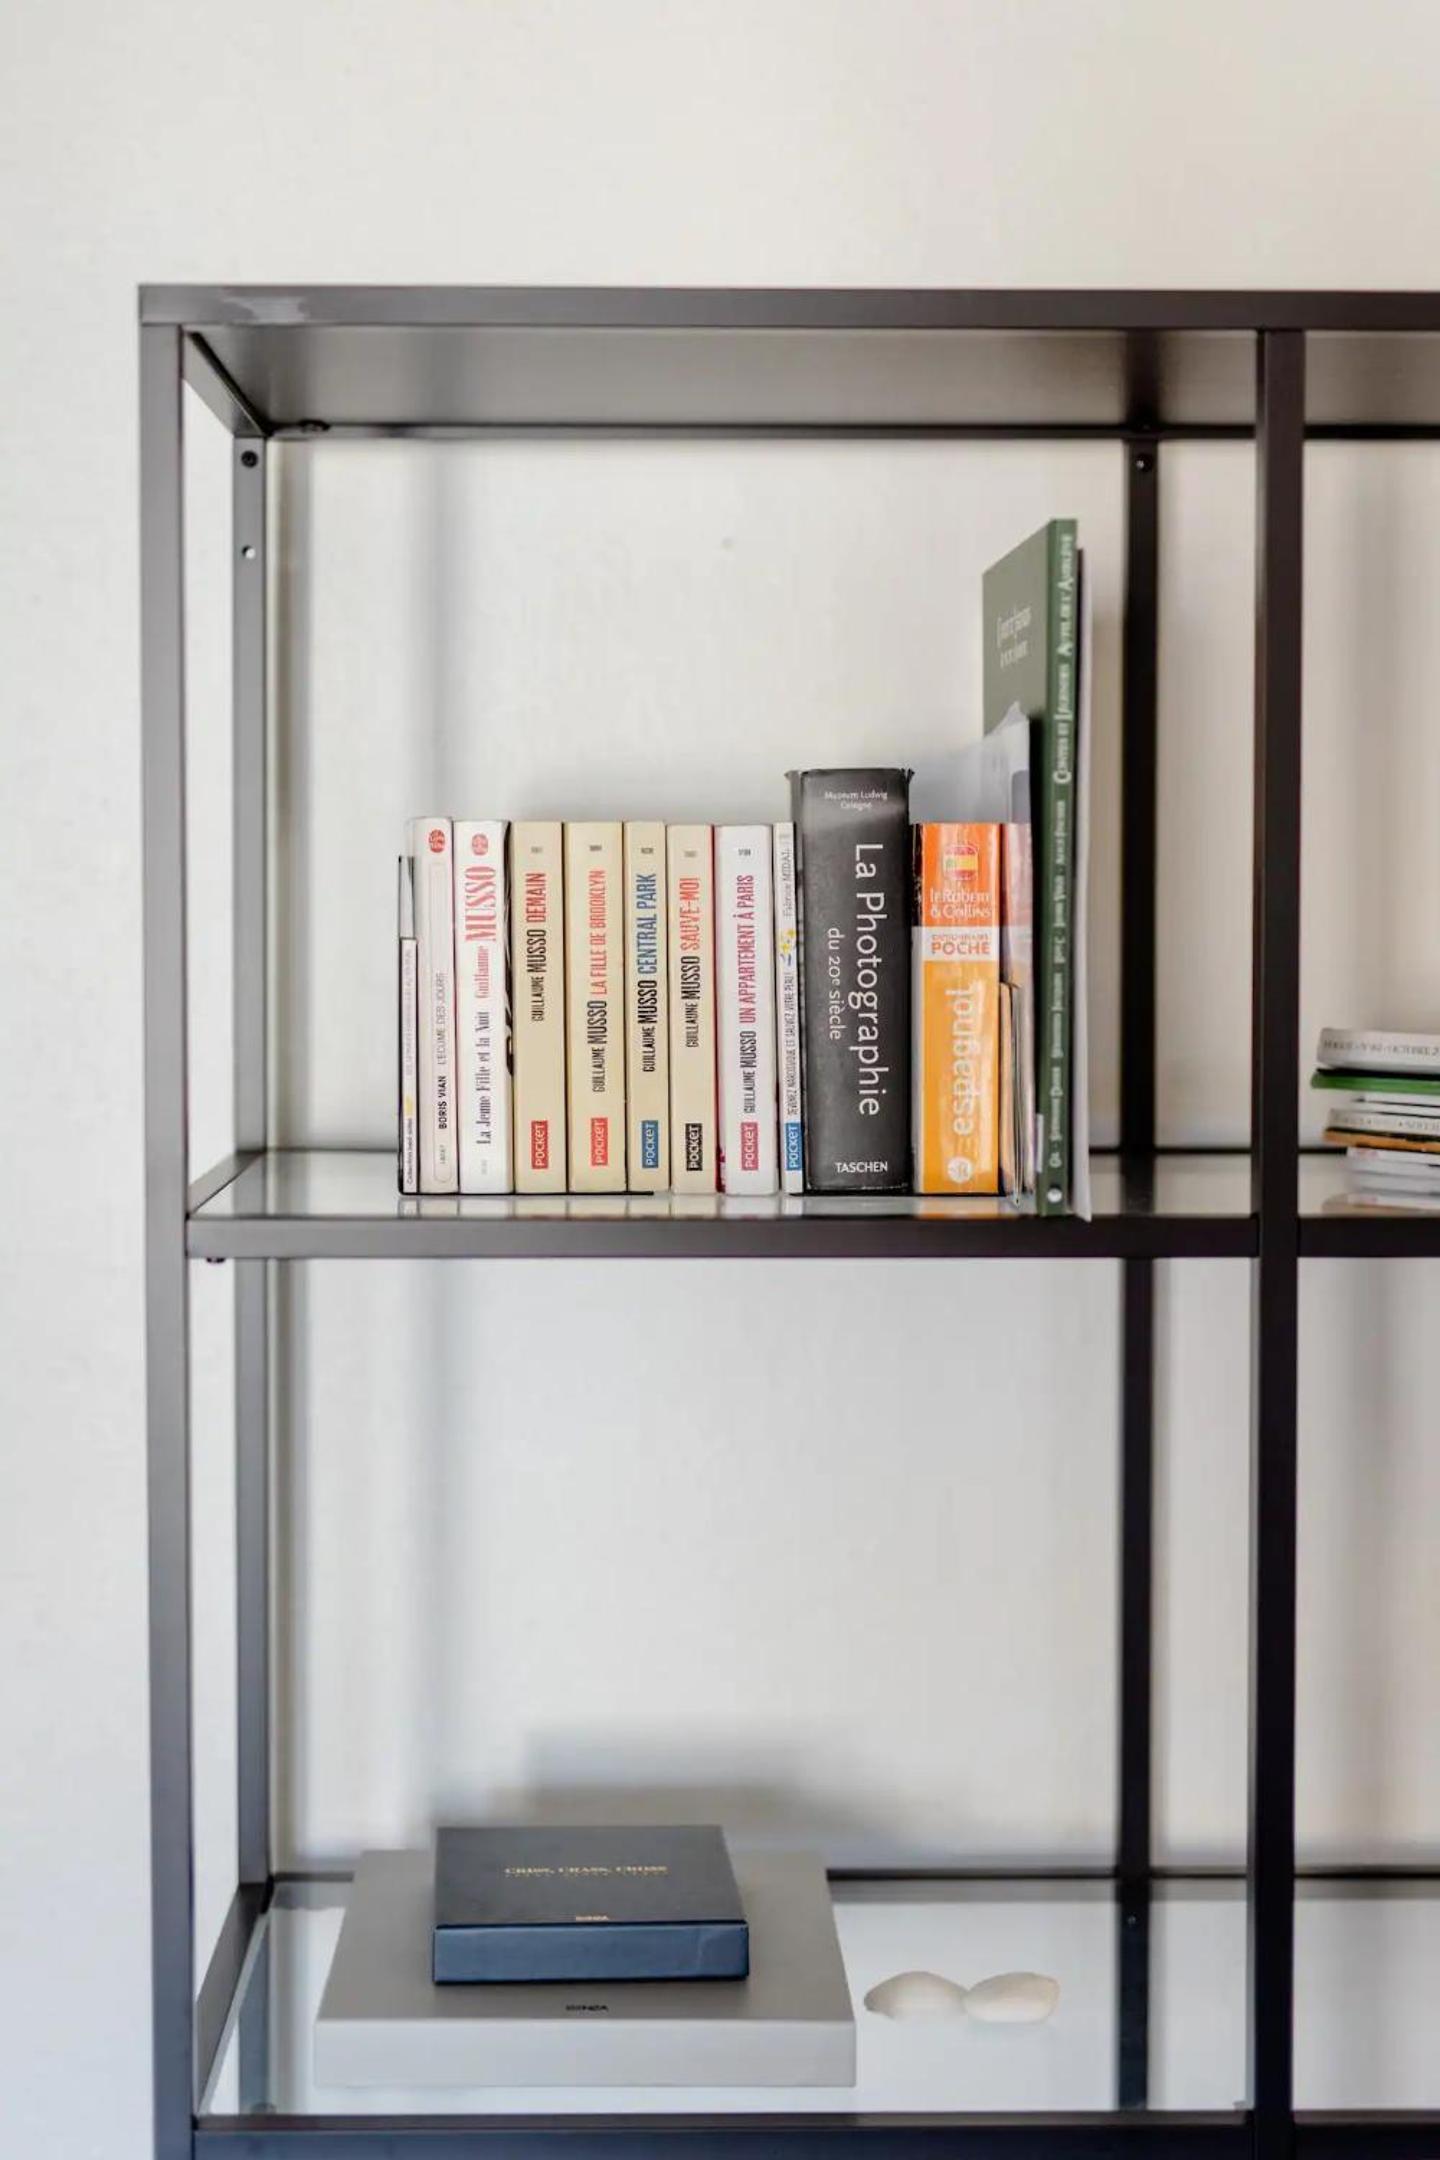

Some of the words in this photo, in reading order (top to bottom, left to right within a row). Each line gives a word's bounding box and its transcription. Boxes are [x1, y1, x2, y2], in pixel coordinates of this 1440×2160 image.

[825, 791, 859, 800] Museum
[861, 790, 888, 801] Ludwig
[855, 843, 884, 879] La
[464, 866, 497, 942] MUSSO
[526, 873, 546, 923] DEMAIN
[588, 870, 606, 929] BROOKLYN
[636, 873, 656, 910] PARK
[737, 874, 754, 908] PARIS
[679, 877, 701, 952] SAUVE-MOI
[732, 911, 754, 921] À
[942, 903, 992, 919] Collins
[527, 929, 546, 973] MUSSO
[590, 933, 606, 945] DE
[637, 913, 657, 975] CENTRAL
[828, 928, 846, 950] du
[931, 942, 990, 955] POCHE
[474, 945, 490, 999] Guillaume
[590, 950, 607, 977] FILLE
[681, 956, 701, 1001] MUSSO
[737, 924, 756, 1004] APPARTEMENT
[531, 976, 545, 1022] GUILLAUME
[590, 980, 607, 995] LA
[638, 980, 657, 1024] MUSSO
[848, 892, 890, 1116] Photographie
[474, 1011, 490, 1033] Nuit
[587, 1000, 607, 1045] MUSSO
[685, 1003, 699, 1048] GUILLAUME
[738, 1007, 756, 1024] UN
[828, 990, 847, 1041] siècle
[475, 1037, 490, 1047] la
[475, 1052, 490, 1062] et
[641, 1026, 656, 1073] GUILLAUME
[740, 1031, 756, 1069] MUSSO
[475, 1067, 491, 1092] Fille
[591, 1047, 605, 1093] GUILLAUME
[945, 987, 982, 1136] espagnol
[437, 1075, 447, 1098] VIAN
[743, 1071, 756, 1114] GUILLAUME
[438, 1100, 448, 1129] BORIS
[475, 1096, 491, 1127] Jeune
[476, 1131, 491, 1145] La
[835, 1161, 888, 1174] TASCHEN
